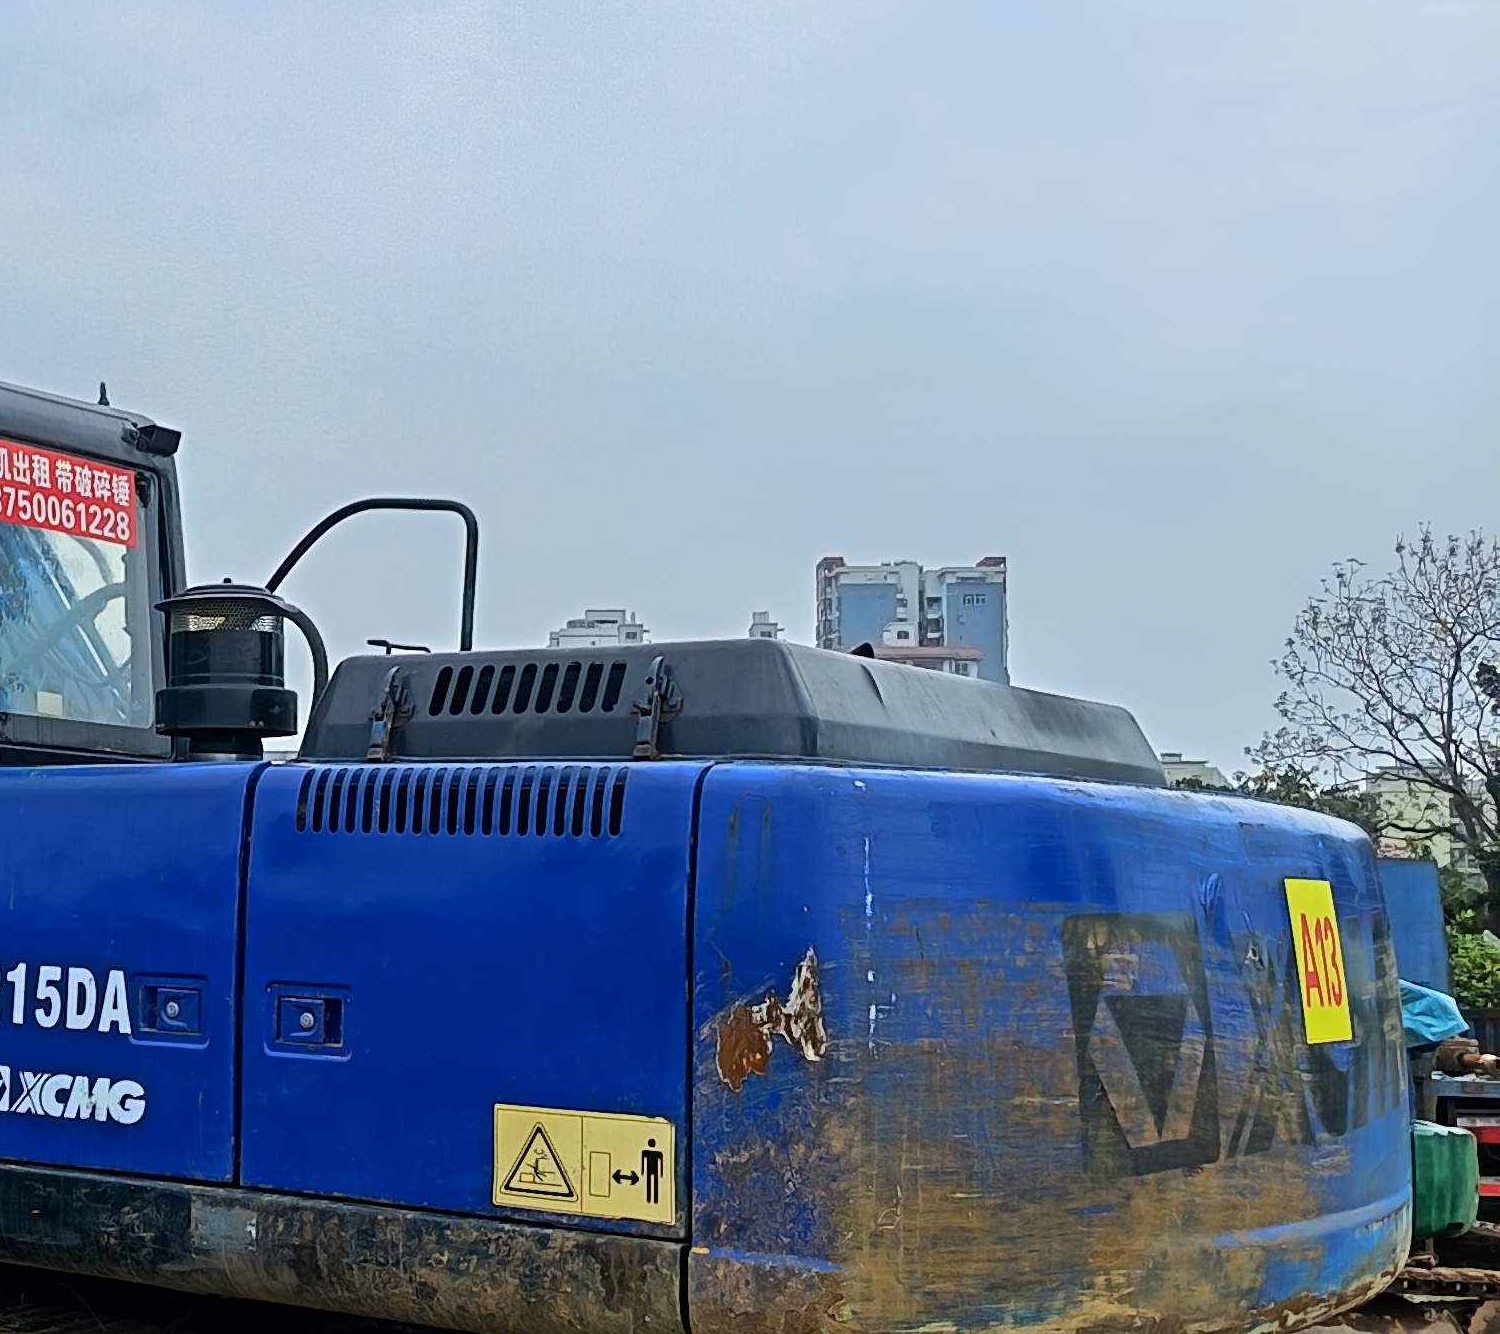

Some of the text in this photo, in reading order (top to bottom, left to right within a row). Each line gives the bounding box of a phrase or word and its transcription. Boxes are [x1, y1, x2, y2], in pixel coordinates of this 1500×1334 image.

[55, 459, 130, 507] 带破碎锤
[1300, 912, 1342, 1008] A13
[9, 1071, 146, 1125] XCMG
